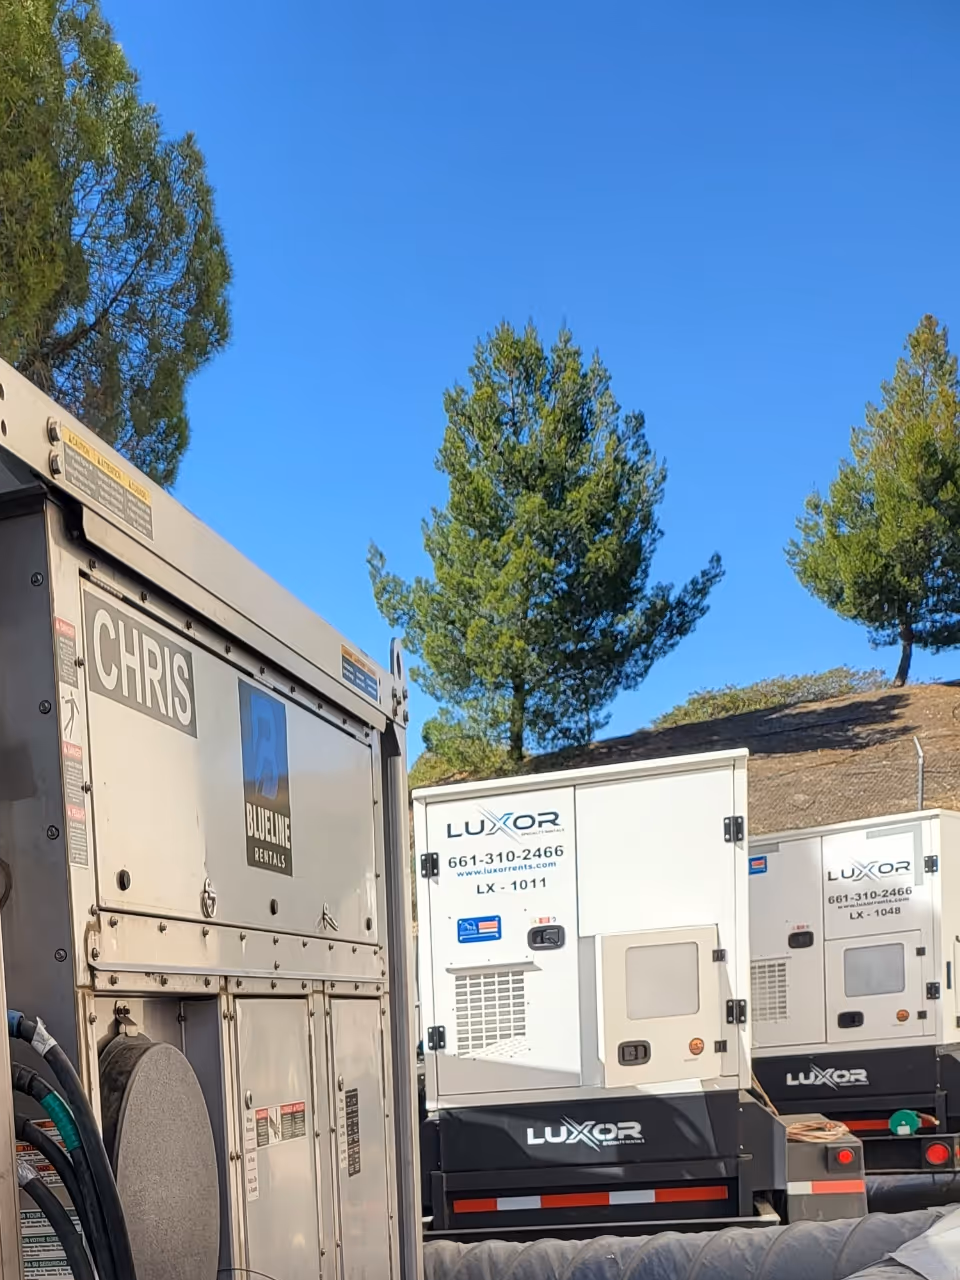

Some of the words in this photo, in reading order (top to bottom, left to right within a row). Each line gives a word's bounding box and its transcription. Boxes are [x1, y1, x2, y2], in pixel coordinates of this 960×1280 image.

[93, 609, 192, 726] CHRIS
[246, 802, 291, 850] BLUELINE
[446, 806, 561, 842] LUXOR
[254, 847, 286, 869] RENTALS
[448, 845, 564, 868] 661-310-2466
[456, 861, 557, 877] www.luxorrents.com
[827, 859, 911, 882] LUXOR
[476, 883, 496, 894] LX
[510, 877, 547, 891] 1011
[827, 886, 913, 905] 661-310-2466
[849, 911, 864, 920] LX
[874, 906, 901, 917] 1048
[786, 1064, 869, 1089] LUXOR
[526, 1117, 643, 1149] LUXOR
